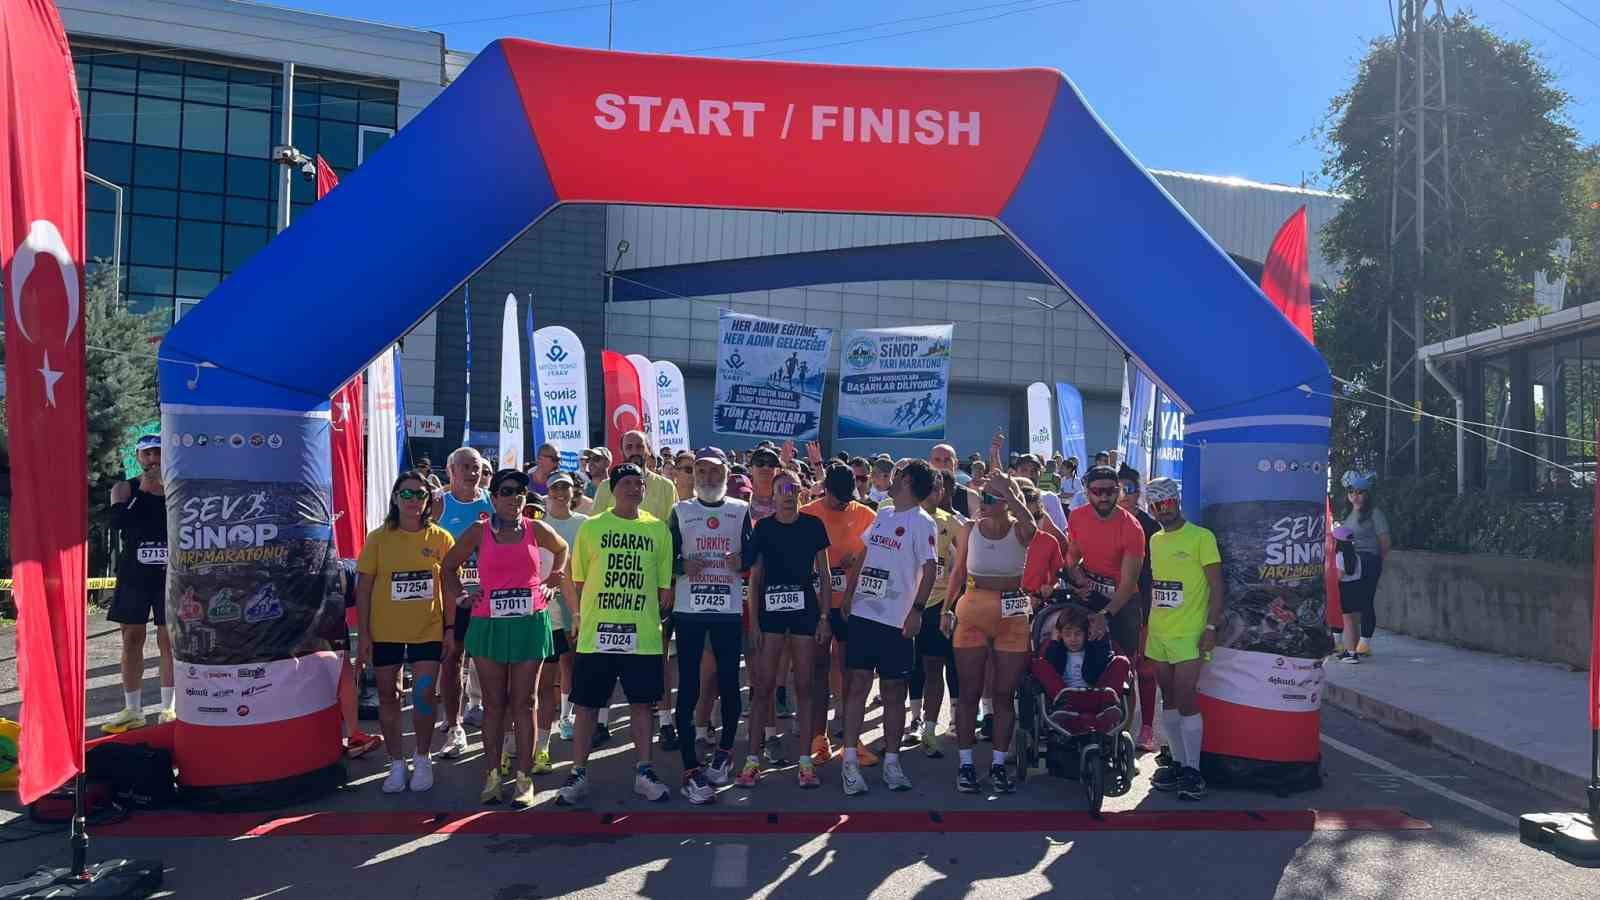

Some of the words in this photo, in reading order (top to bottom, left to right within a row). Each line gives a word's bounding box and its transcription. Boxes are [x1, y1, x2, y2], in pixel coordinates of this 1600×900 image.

[594, 93, 765, 138] START
[781, 103, 794, 140] /
[812, 105, 981, 146] FINISH
[731, 319, 751, 333] HER
[753, 321, 780, 335] ADIM
[724, 332, 743, 345] HER
[745, 334, 774, 347] ADIM
[847, 382, 895, 393] BAŞARILAR
[747, 408, 806, 424] SPORCULARA
[608, 550, 643, 571] DEĞİL
[396, 581, 427, 593] 57254
[604, 571, 645, 589] SPORU
[495, 599, 527, 611] 57011
[598, 588, 633, 610] TERCİH
[634, 594, 646, 611] ET
[695, 594, 725, 606] 57425
[600, 633, 631, 645] 57024
